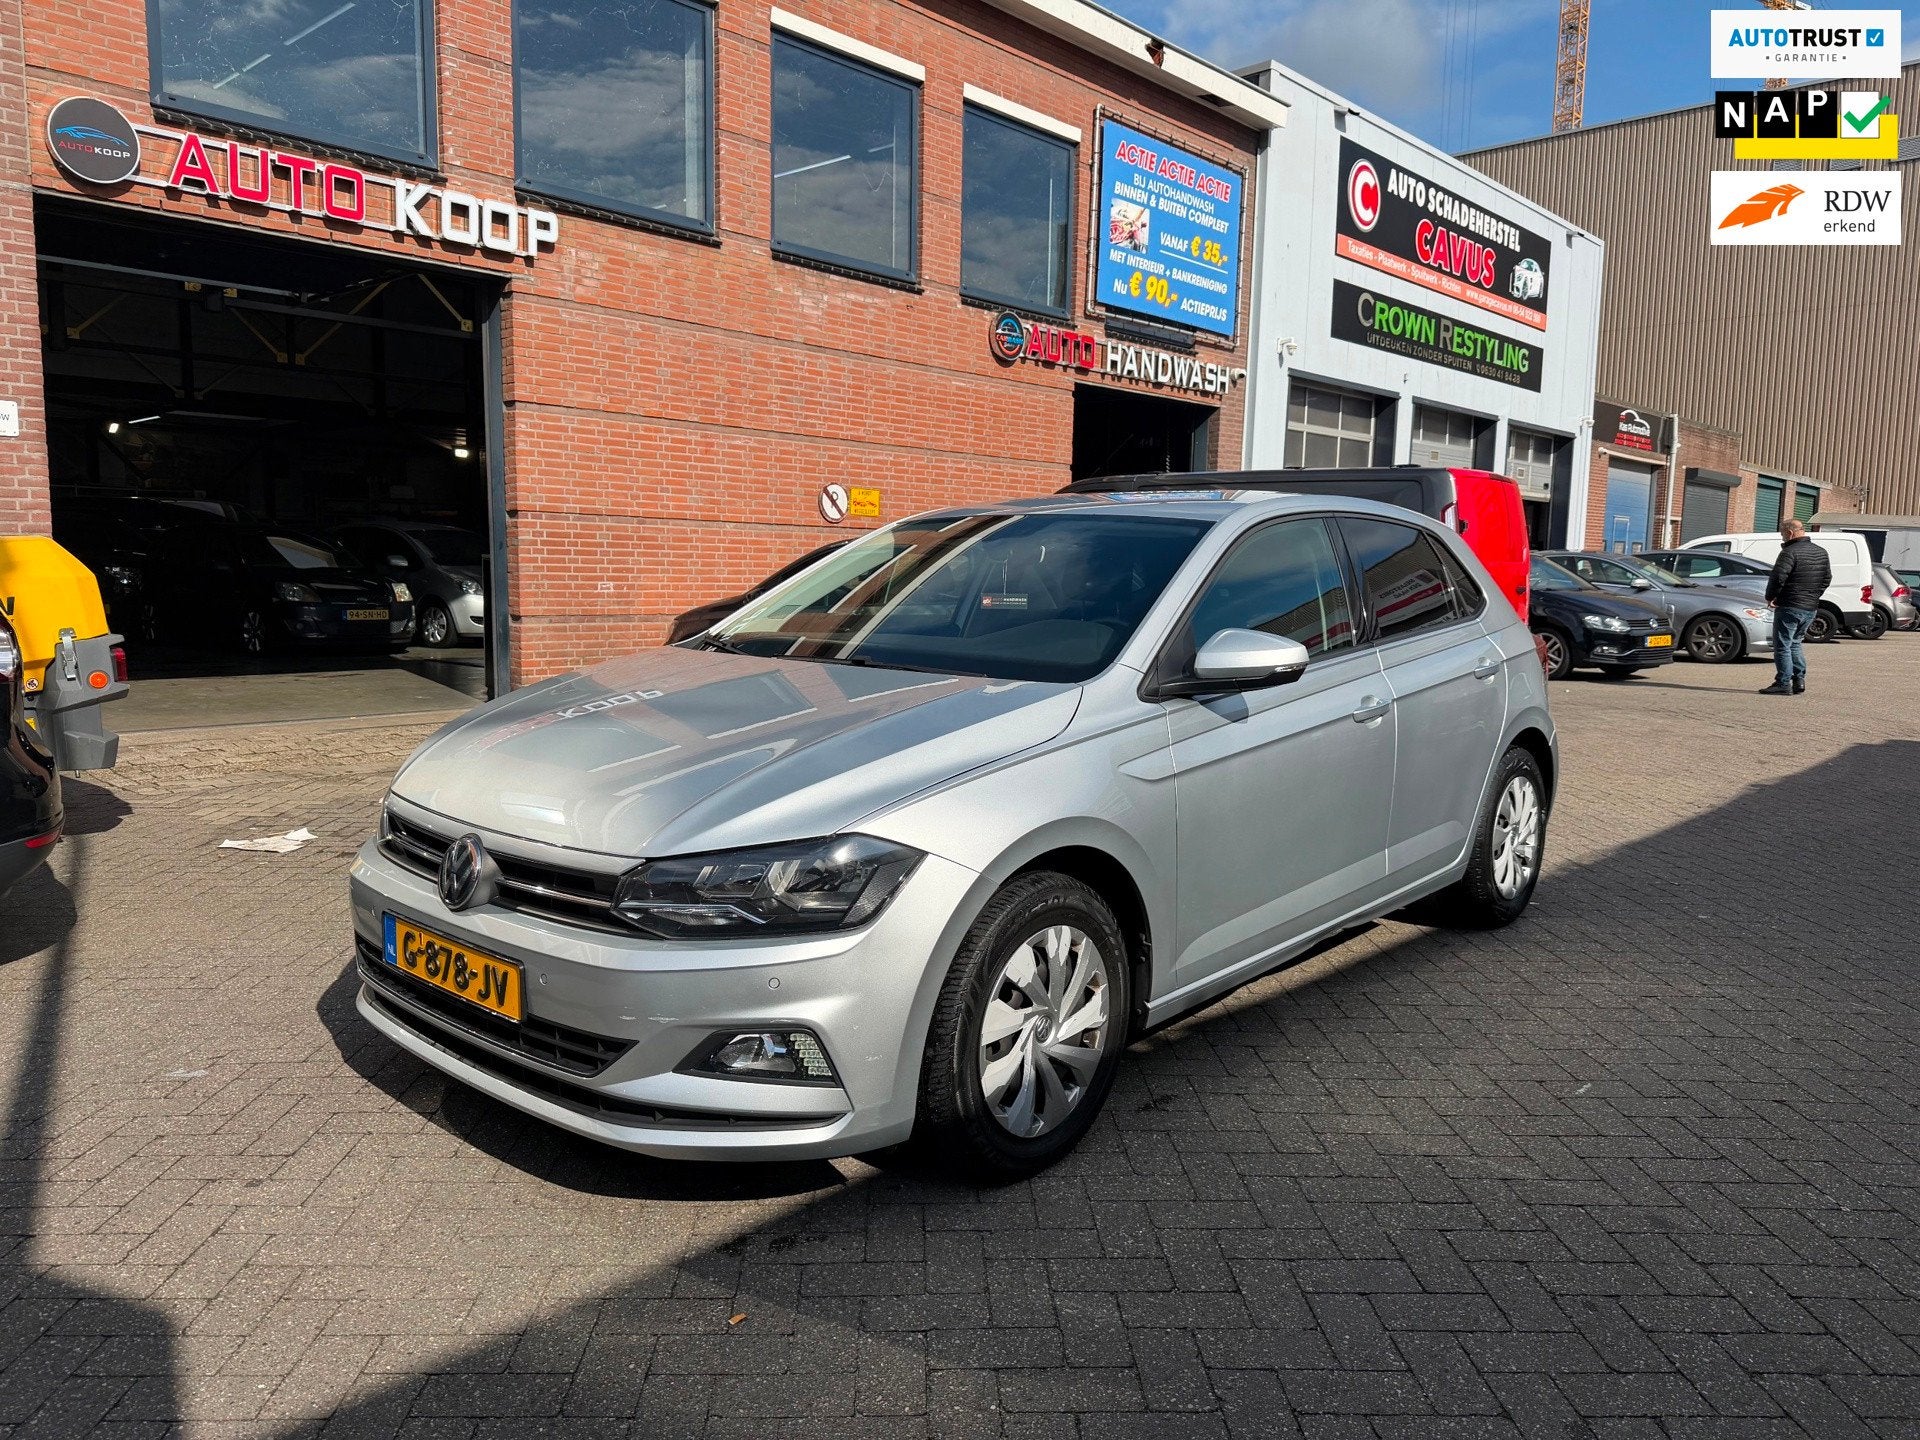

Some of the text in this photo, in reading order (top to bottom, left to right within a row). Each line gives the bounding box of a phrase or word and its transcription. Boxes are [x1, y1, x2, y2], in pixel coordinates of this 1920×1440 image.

[58, 140, 130, 159] AUTOKOOP
[1115, 140, 1232, 202] ACTIE ACTIE ACTIE
[170, 132, 560, 258] AUTO KOOP
[1114, 181, 1230, 234] BINNEN & BUITEN COMPLEET
[1134, 173, 1214, 214] BIJ AUTOHANDWASH
[1387, 168, 1521, 253] AUTO SCHADEHERSTEL
[1160, 231, 1188, 252] VANAF
[1347, 240, 1374, 260] Taxaties
[1378, 253, 1407, 272] Plaatwerk
[1410, 265, 1438, 286] Spuitwerk
[1415, 218, 1496, 288] CAVUS
[1109, 249, 1126, 264] MET
[1127, 254, 1164, 276] INTERIEUR
[1172, 267, 1228, 295] BANKREINIGING
[1180, 297, 1228, 322] ACTIEPRIJS
[1357, 292, 1529, 373] CROWN RESTYLING
[1026, 324, 1230, 394] AUTO HANDWASH
[1366, 332, 1412, 354] UITDEUKEN
[1413, 345, 1442, 362] ZONDER
[1443, 353, 1473, 372] SPUITEN
[403, 930, 508, 1008] G-878-JV
